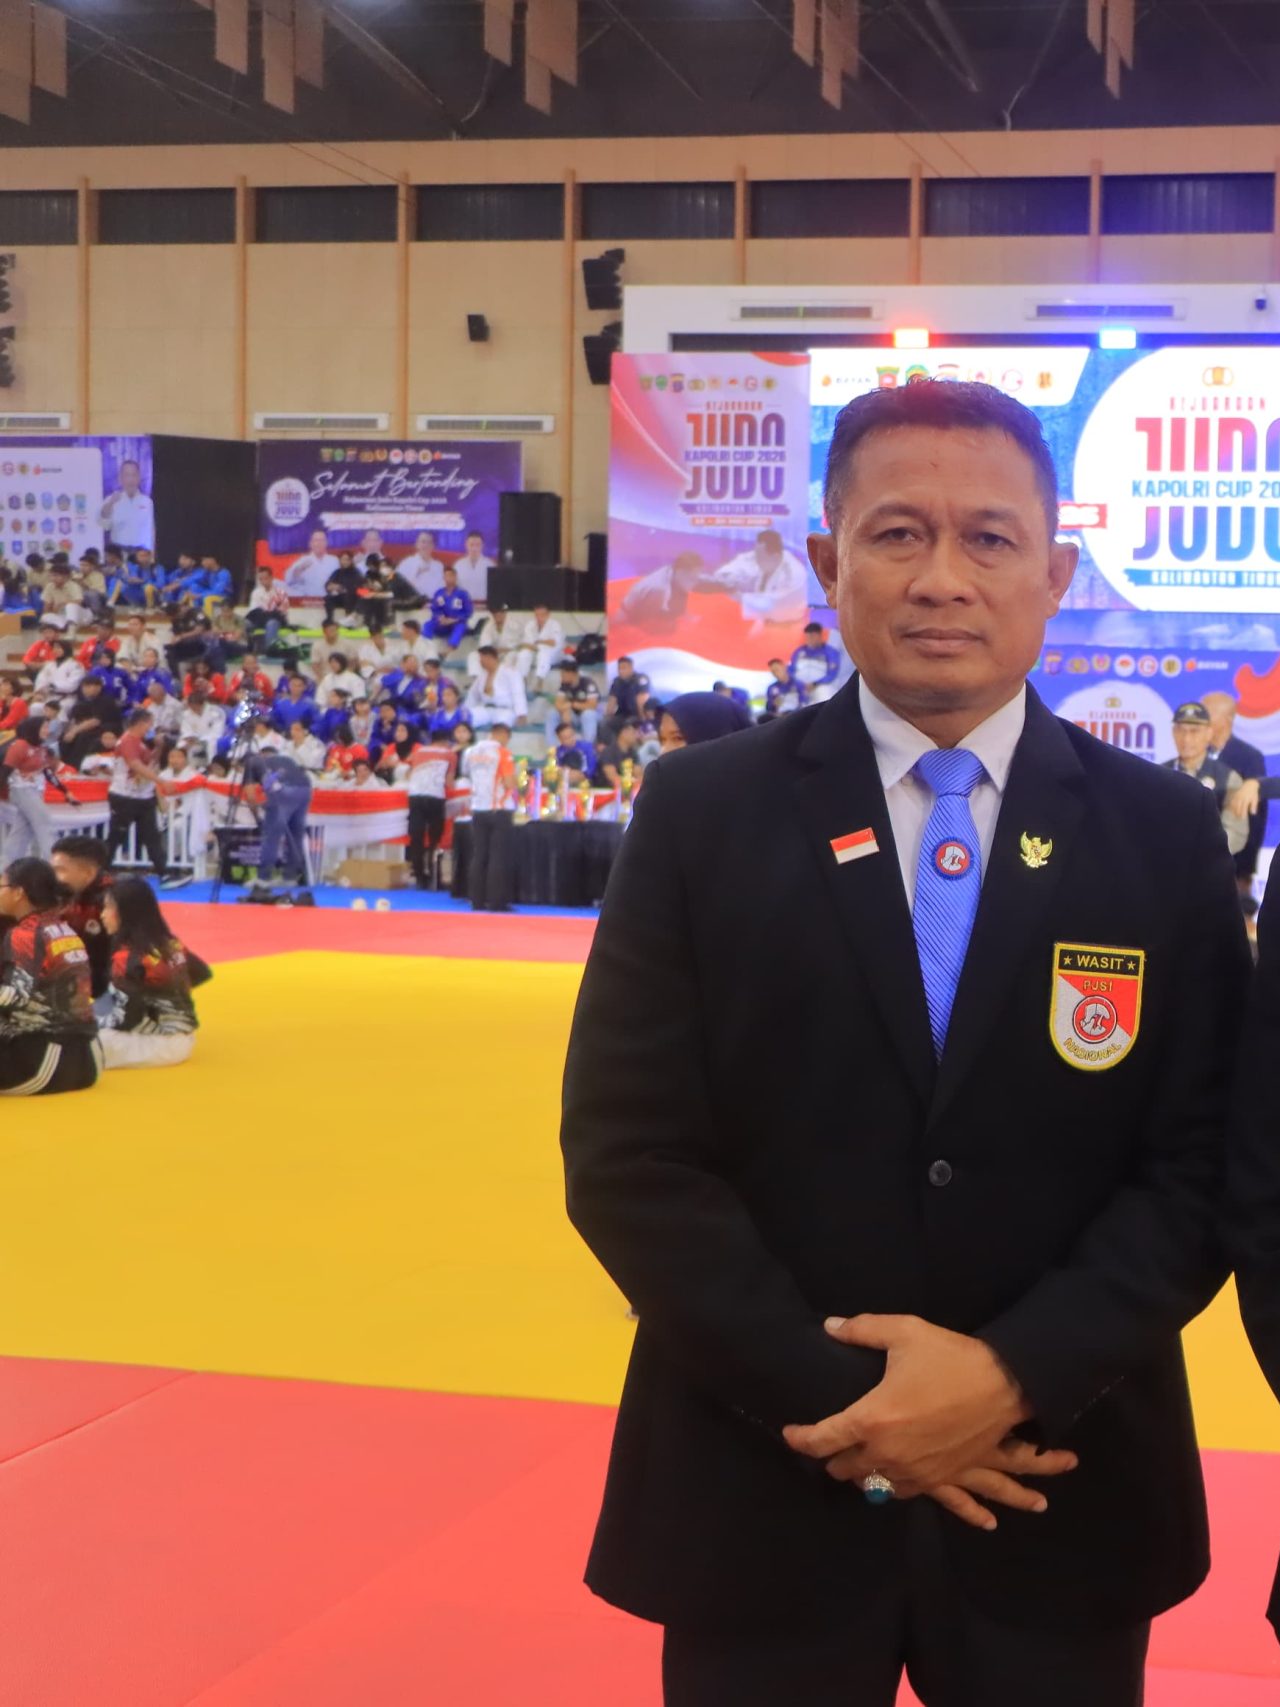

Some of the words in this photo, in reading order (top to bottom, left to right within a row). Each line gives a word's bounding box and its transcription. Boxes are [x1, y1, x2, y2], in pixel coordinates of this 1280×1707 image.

[733, 450, 755, 462] CUP
[1132, 480, 1210, 498] KAPOLRI
[1216, 480, 1253, 498] CUP
[1077, 955, 1125, 970] WASIT
[1083, 980, 1113, 992] PJSI
[1063, 1037, 1122, 1062] NASIONAL
